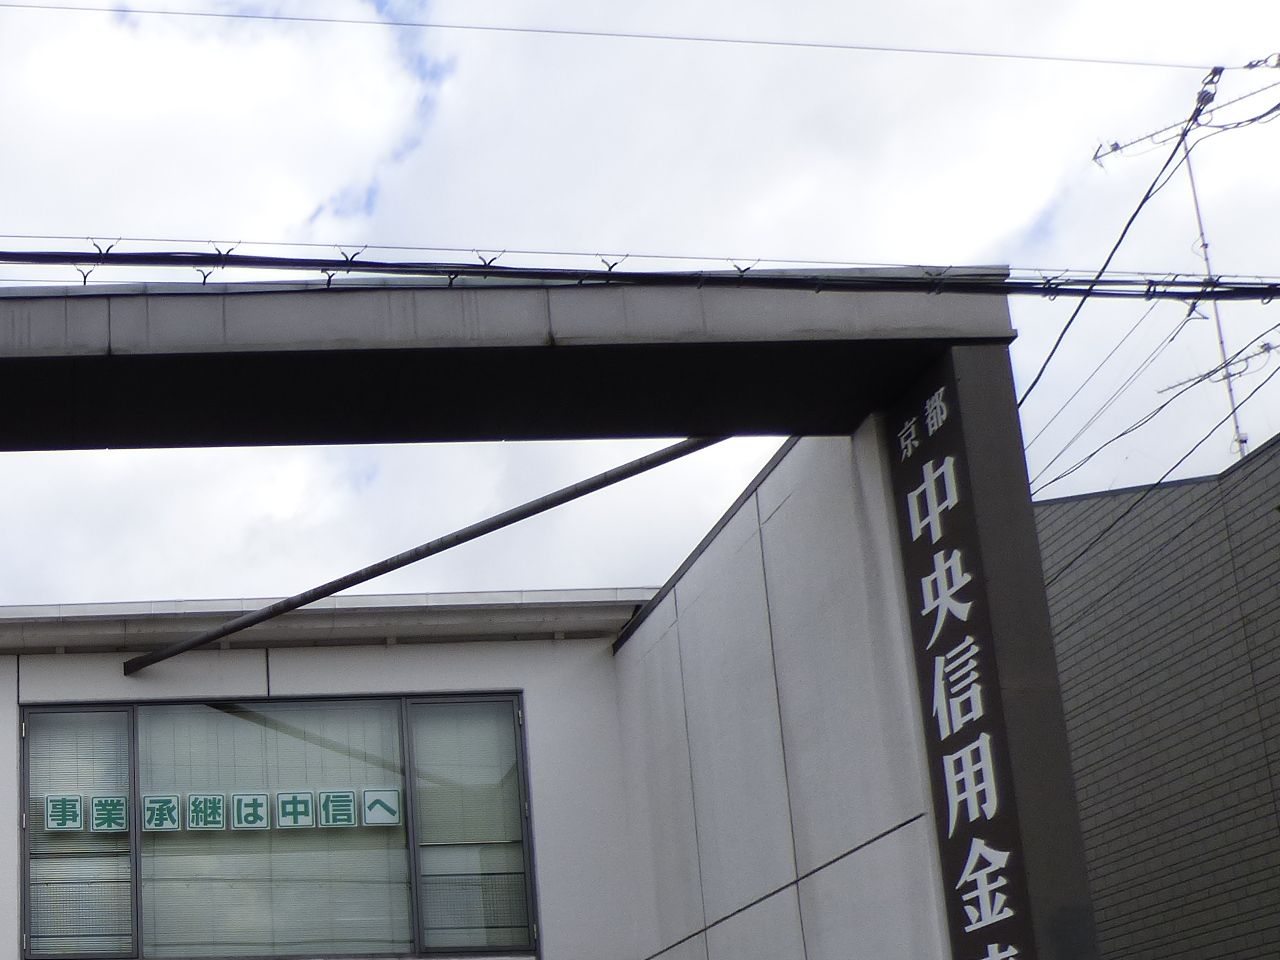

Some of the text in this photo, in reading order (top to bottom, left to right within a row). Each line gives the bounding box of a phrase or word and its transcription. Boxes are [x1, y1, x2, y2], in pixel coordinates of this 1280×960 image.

[897, 386, 948, 463] 京都
[49, 795, 397, 828] 事業承継は中信へ
